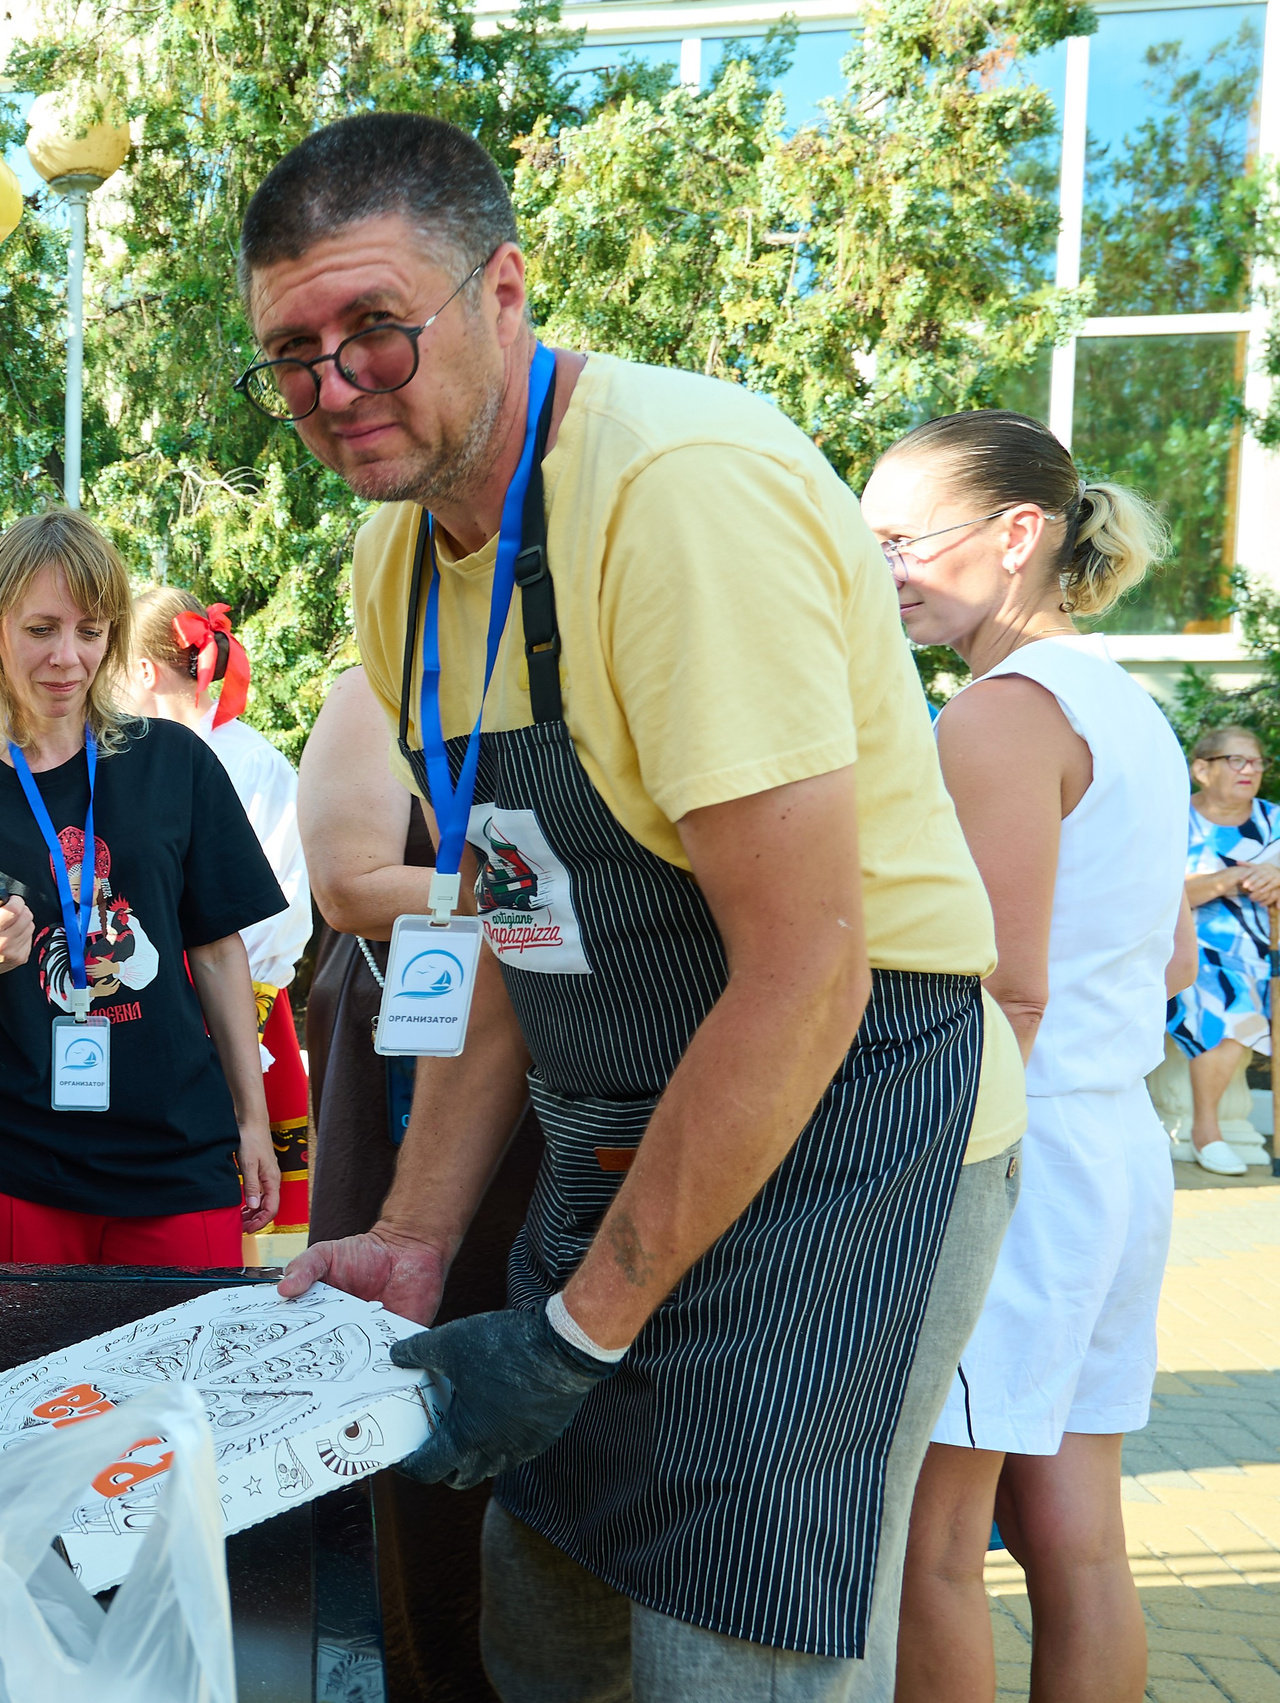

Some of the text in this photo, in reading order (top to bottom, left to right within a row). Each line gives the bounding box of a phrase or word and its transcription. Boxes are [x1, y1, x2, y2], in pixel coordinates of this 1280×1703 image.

[492, 911, 534, 929] artigiano
[388, 1015, 458, 1024] ОРГАНИЗАТОР
[97, 1317, 177, 1353] Seafood
[4, 1366, 49, 1398] Cheese
[216, 1402, 322, 1461] Pepperoni
